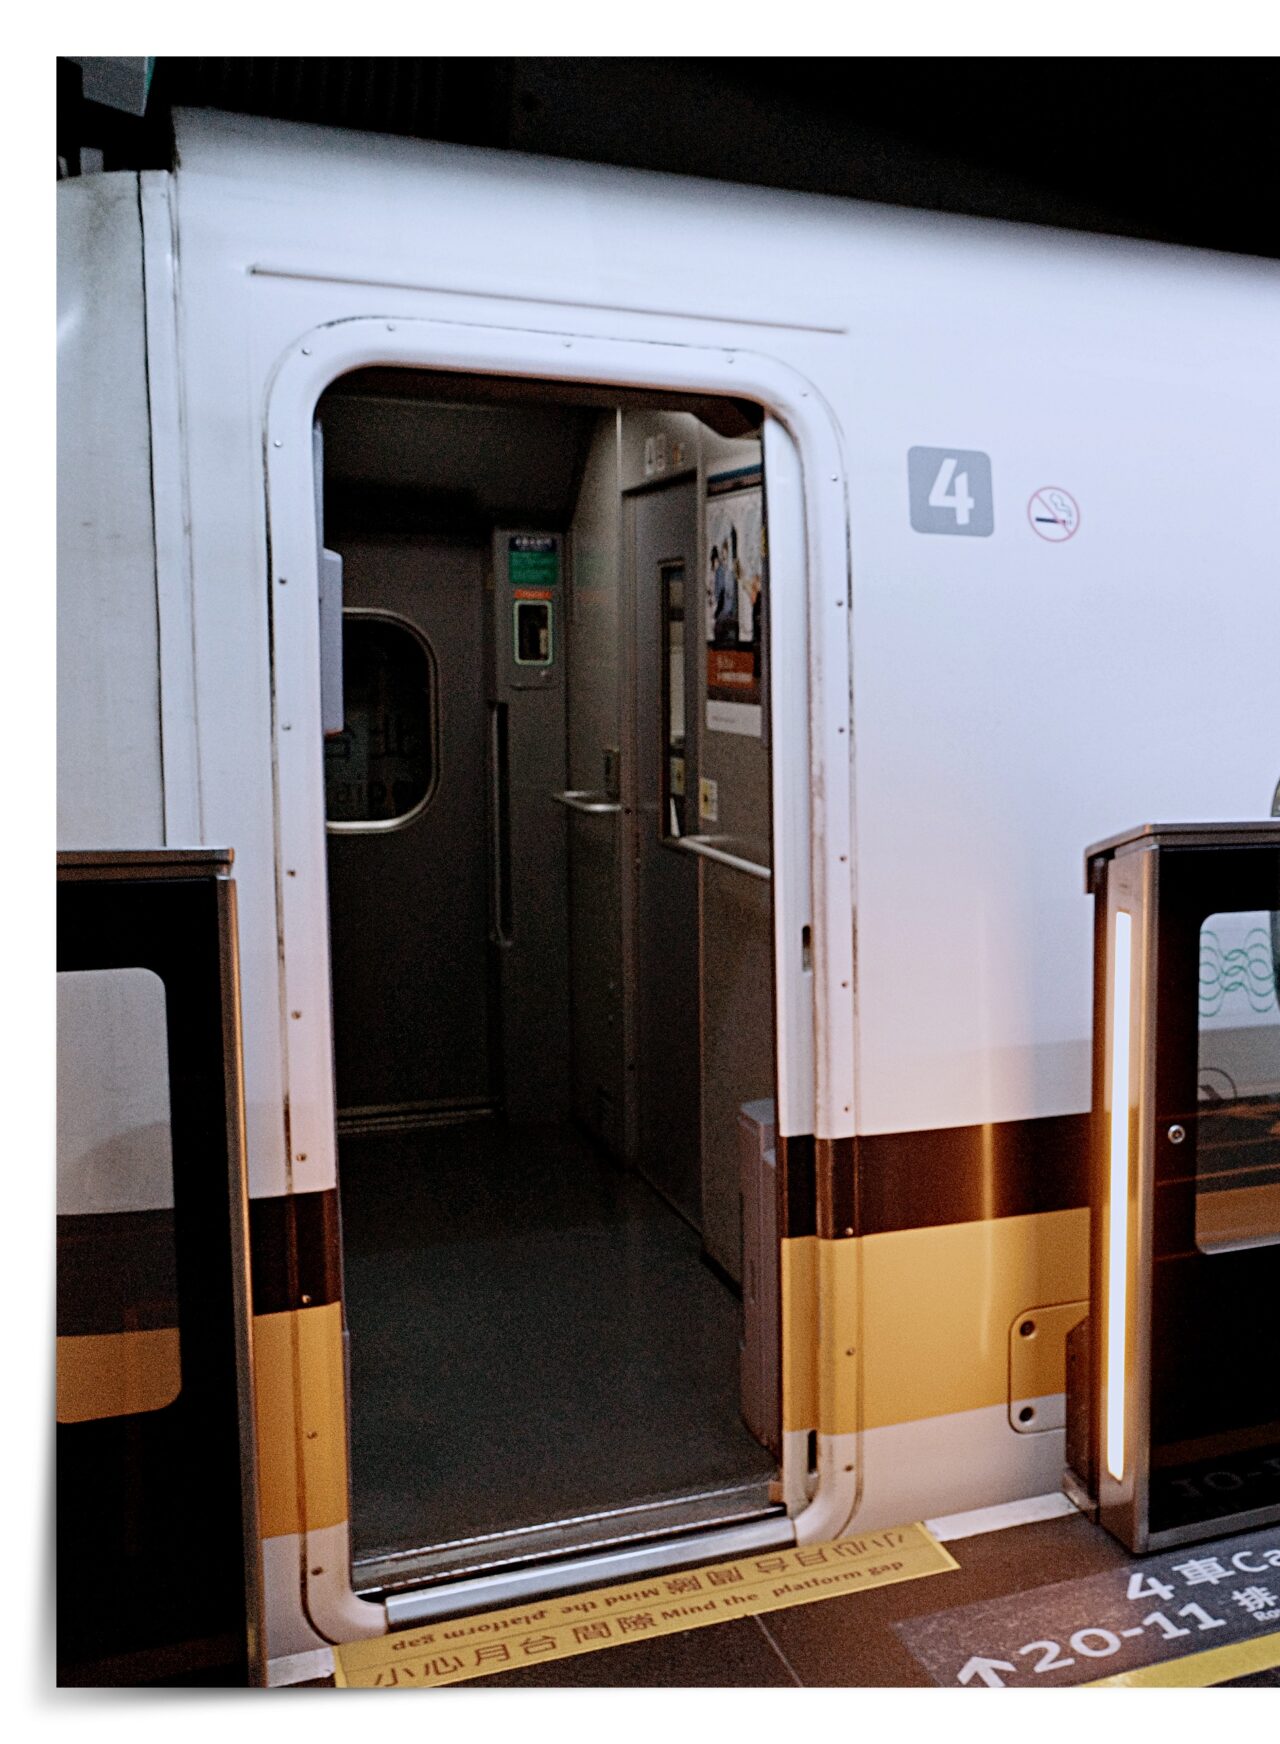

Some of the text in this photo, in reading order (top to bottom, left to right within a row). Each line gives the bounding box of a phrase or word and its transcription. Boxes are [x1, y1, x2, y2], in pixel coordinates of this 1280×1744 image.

[928, 457, 974, 526] 4
[603, 1587, 661, 1608] Mind
[661, 1599, 716, 1621] Mind
[724, 1591, 759, 1609] the
[771, 1569, 863, 1598] platform
[868, 1559, 905, 1577] gap
[561, 1599, 598, 1615] the
[443, 1610, 549, 1639] platform
[1018, 1602, 1228, 1674] 20-11
[1231, 1585, 1279, 1613] 排
[391, 1635, 437, 1652] gap
